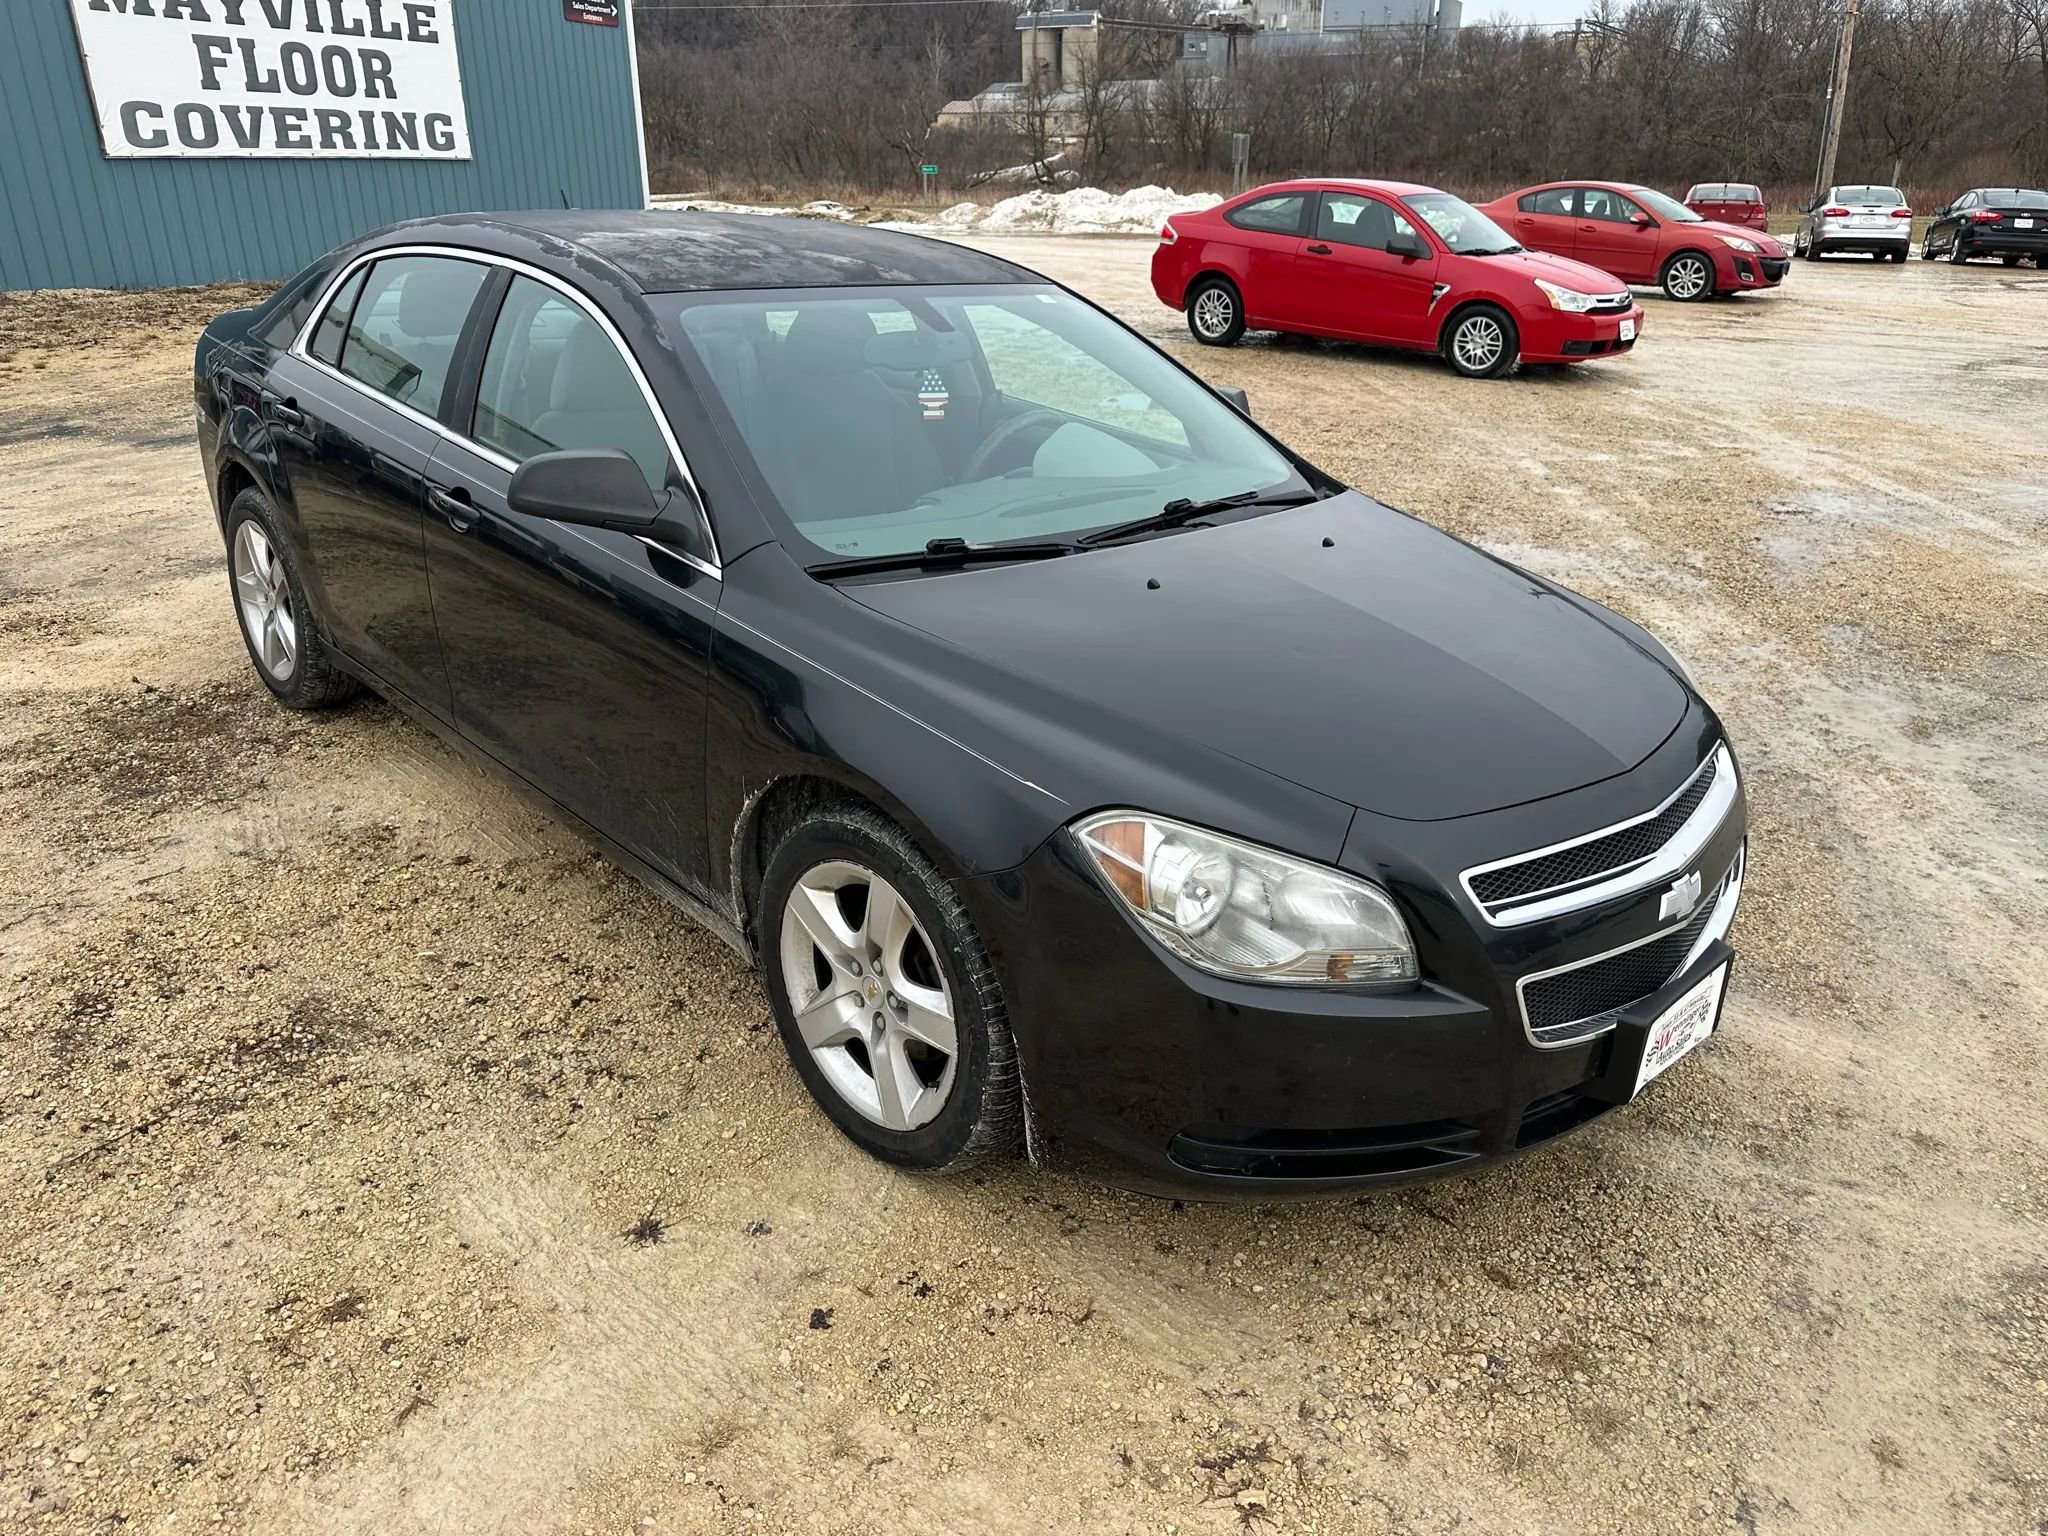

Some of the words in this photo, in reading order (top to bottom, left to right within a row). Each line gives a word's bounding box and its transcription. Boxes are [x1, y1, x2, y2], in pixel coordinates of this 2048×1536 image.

[88, 0, 439, 44] YVILLE
[572, 1, 585, 10] Sales
[584, 3, 611, 14] Department
[583, 12, 602, 22] Entrance
[191, 34, 398, 100] FLOOR
[119, 100, 456, 151] COVERING
